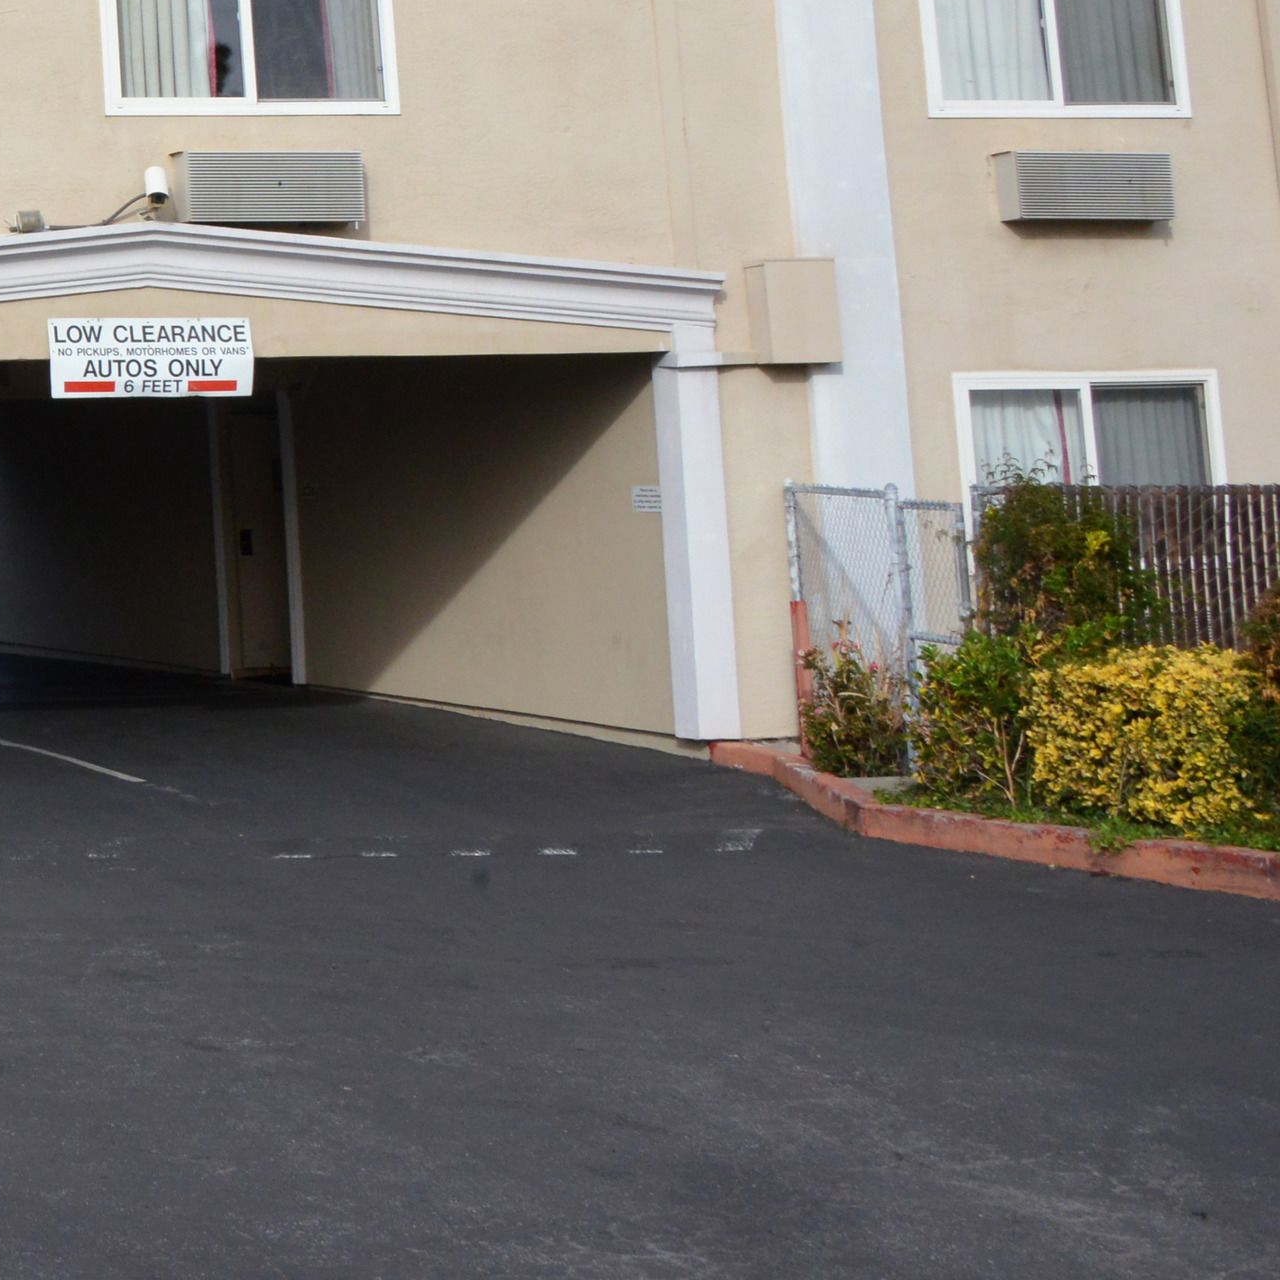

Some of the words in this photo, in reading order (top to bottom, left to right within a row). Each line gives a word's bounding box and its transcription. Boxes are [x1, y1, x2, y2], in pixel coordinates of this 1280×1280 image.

[53, 325, 102, 343] LOW
[113, 325, 247, 343] CLEARANCE
[57, 347, 73, 357] NO
[76, 347, 122, 357] PICKUPS,
[126, 347, 198, 356] MOTORHOMES
[202, 347, 216, 356] OR
[220, 346, 246, 356] VANS
[83, 359, 157, 377] AUTOS
[168, 358, 223, 377] ONLY
[124, 379, 134, 393] 6
[142, 379, 183, 393] FEET
